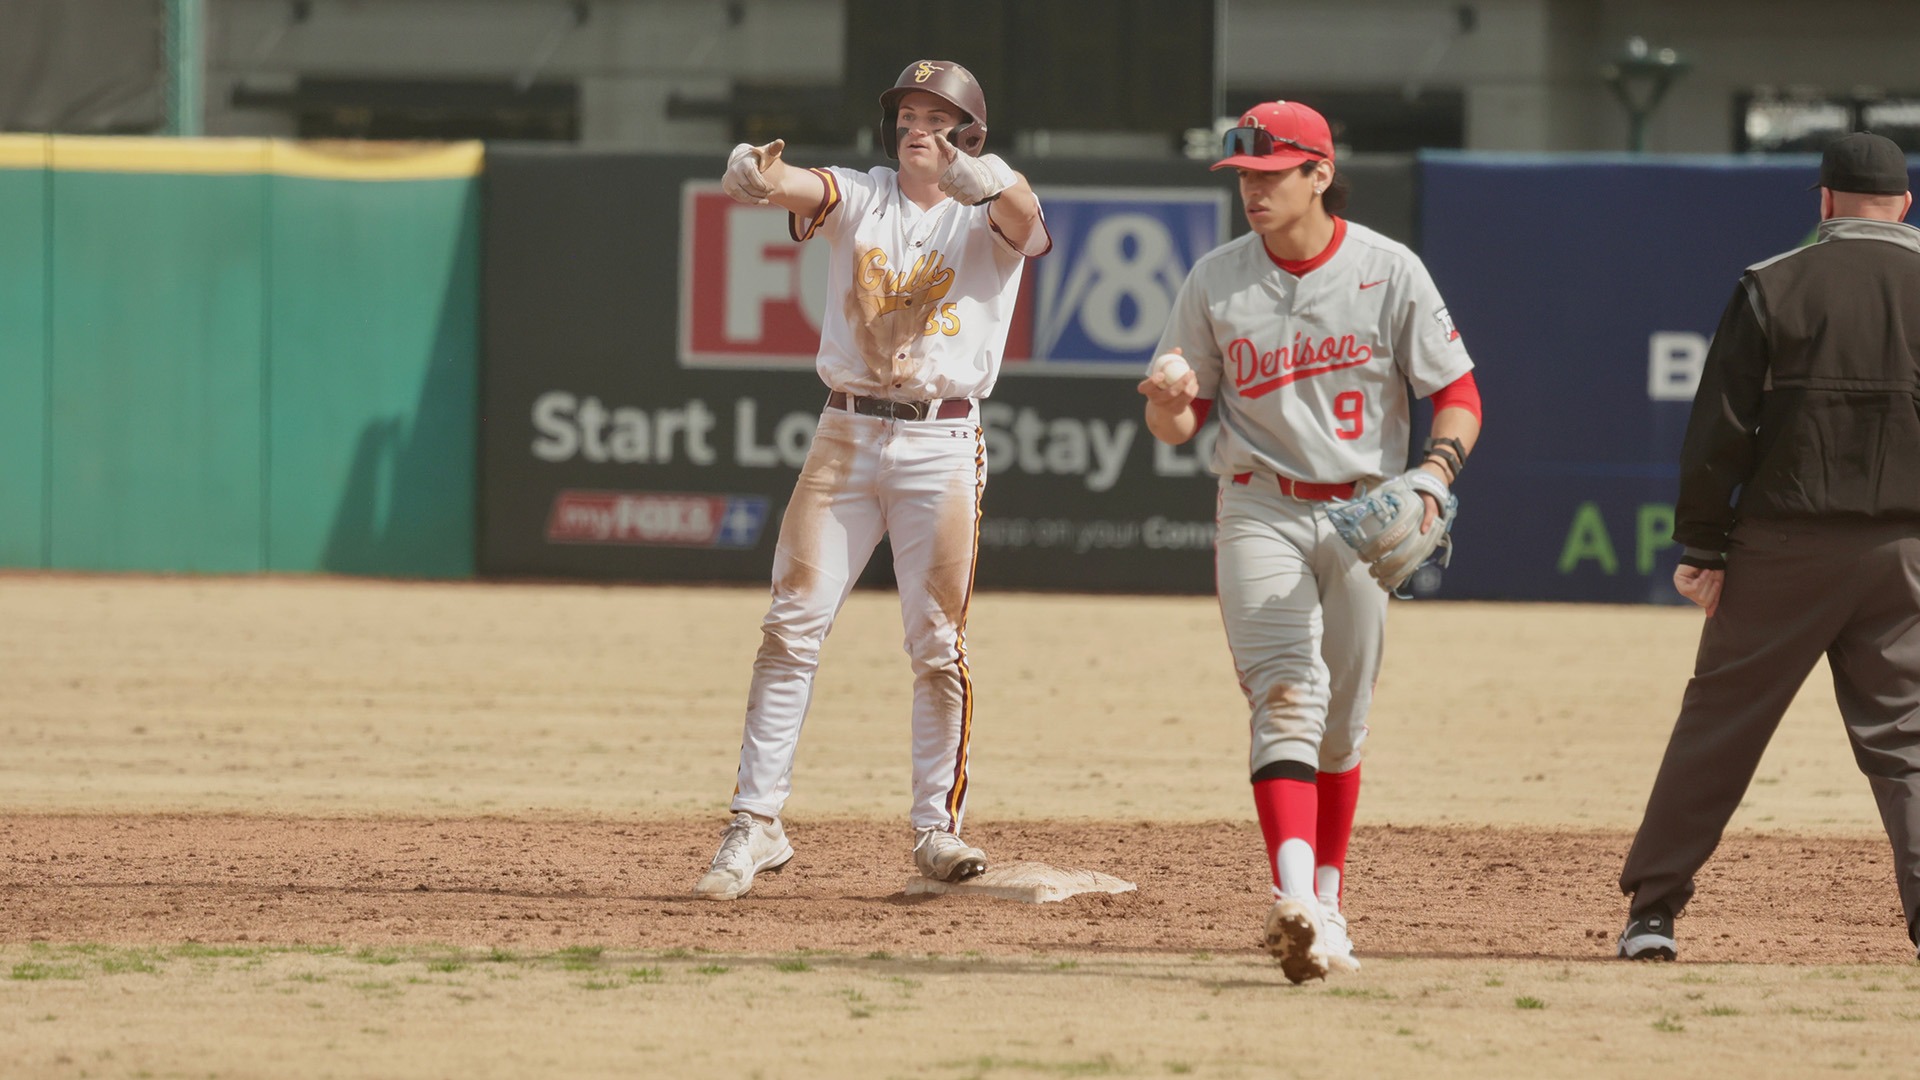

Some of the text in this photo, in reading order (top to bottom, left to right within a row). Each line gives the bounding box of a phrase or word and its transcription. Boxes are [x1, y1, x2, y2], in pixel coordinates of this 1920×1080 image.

[857, 247, 955, 305] Gulls
[1080, 213, 1178, 353] 8
[1228, 331, 1372, 395] Denison
[1647, 331, 1714, 400] B
[531, 391, 717, 466] Start
[983, 403, 1138, 492] Stay
[1333, 390, 1364, 440] 9
